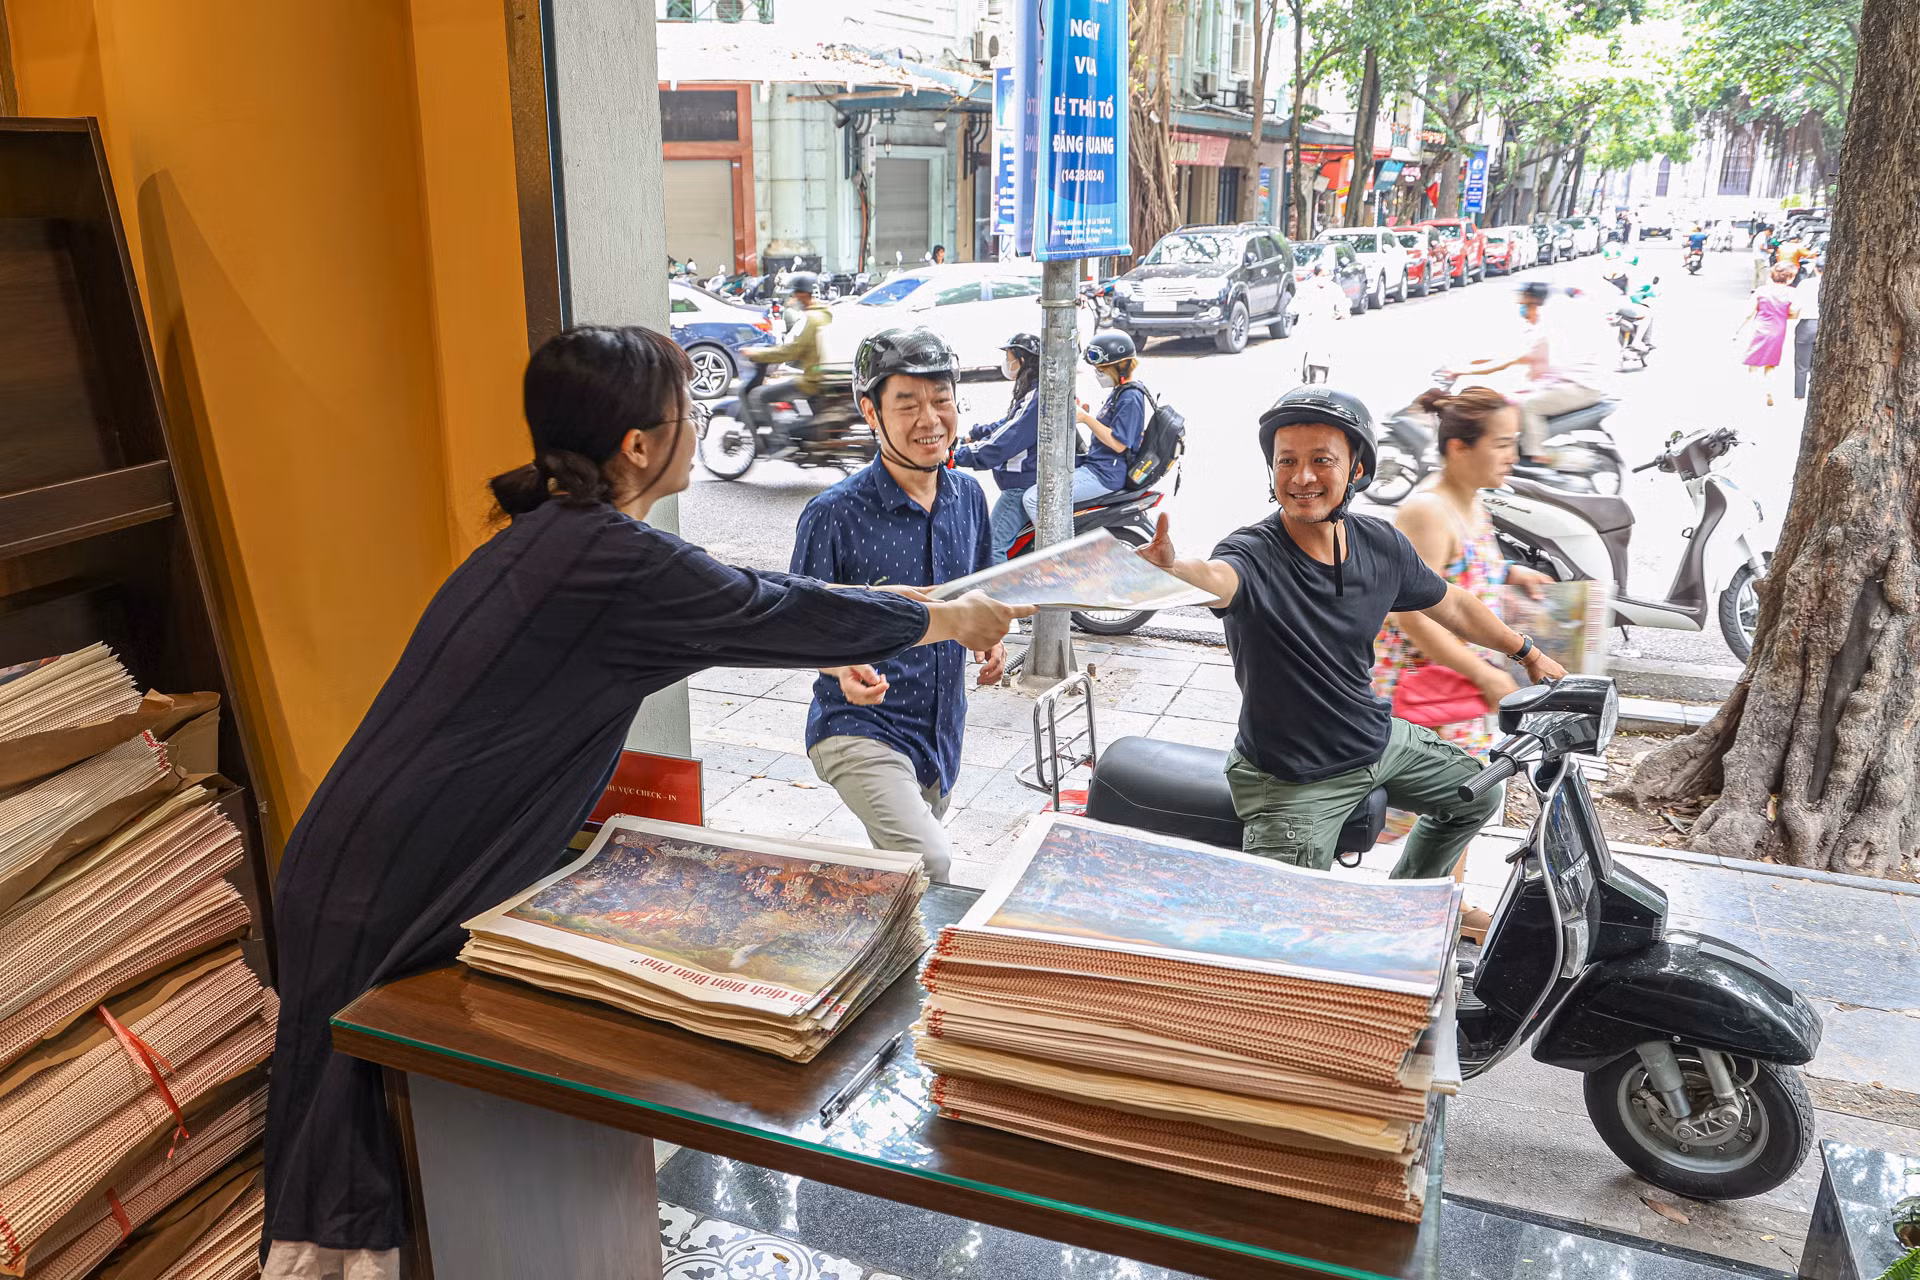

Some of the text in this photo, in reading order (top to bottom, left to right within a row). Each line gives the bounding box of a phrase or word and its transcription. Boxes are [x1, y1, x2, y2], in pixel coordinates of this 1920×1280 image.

[1098, 94, 1114, 119] TỔ
[1052, 130, 1084, 154] ĐĂNG
[607, 784, 617, 792] HU
[636, 789, 662, 800] CHECK
